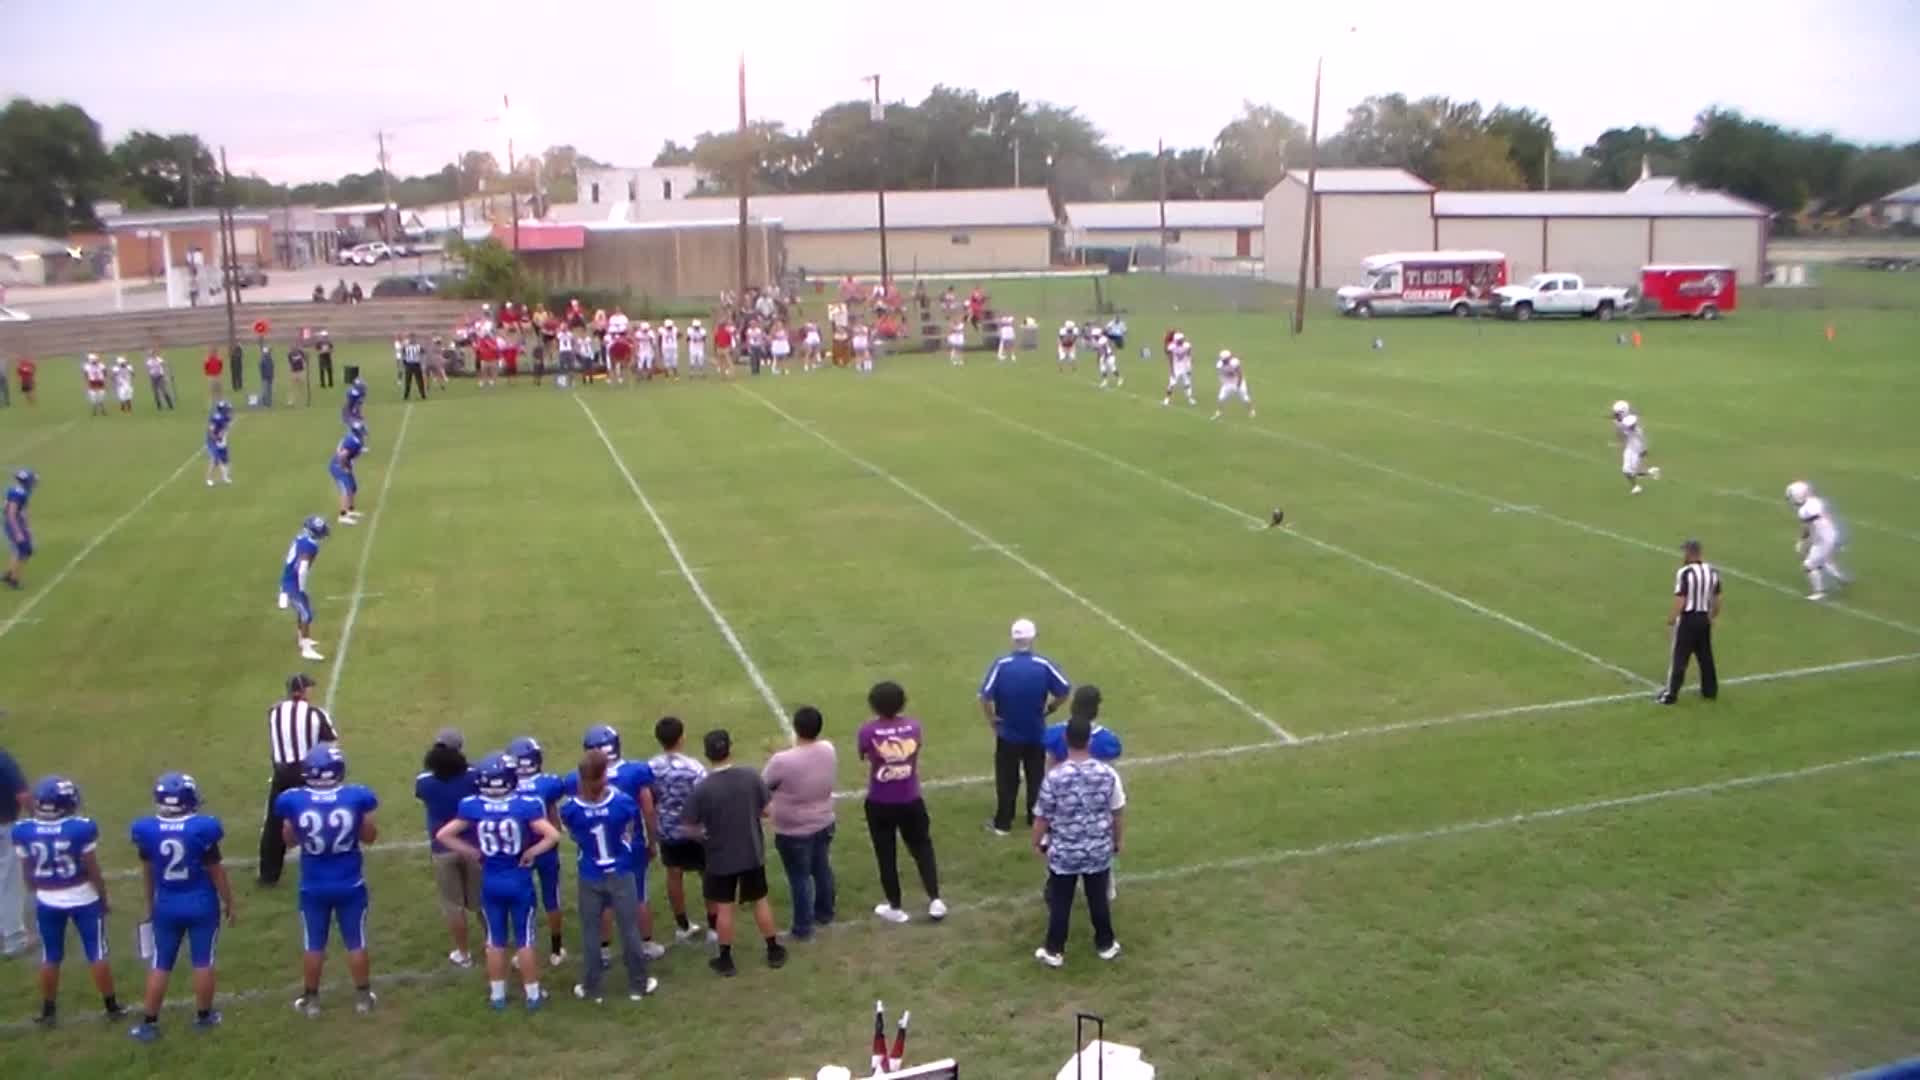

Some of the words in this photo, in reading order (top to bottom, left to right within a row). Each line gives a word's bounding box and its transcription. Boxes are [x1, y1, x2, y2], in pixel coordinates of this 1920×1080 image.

[299, 808, 354, 855] 32
[477, 818, 522, 857] 69
[590, 823, 616, 866] 1
[30, 840, 77, 879] 25
[159, 838, 189, 881] 2
